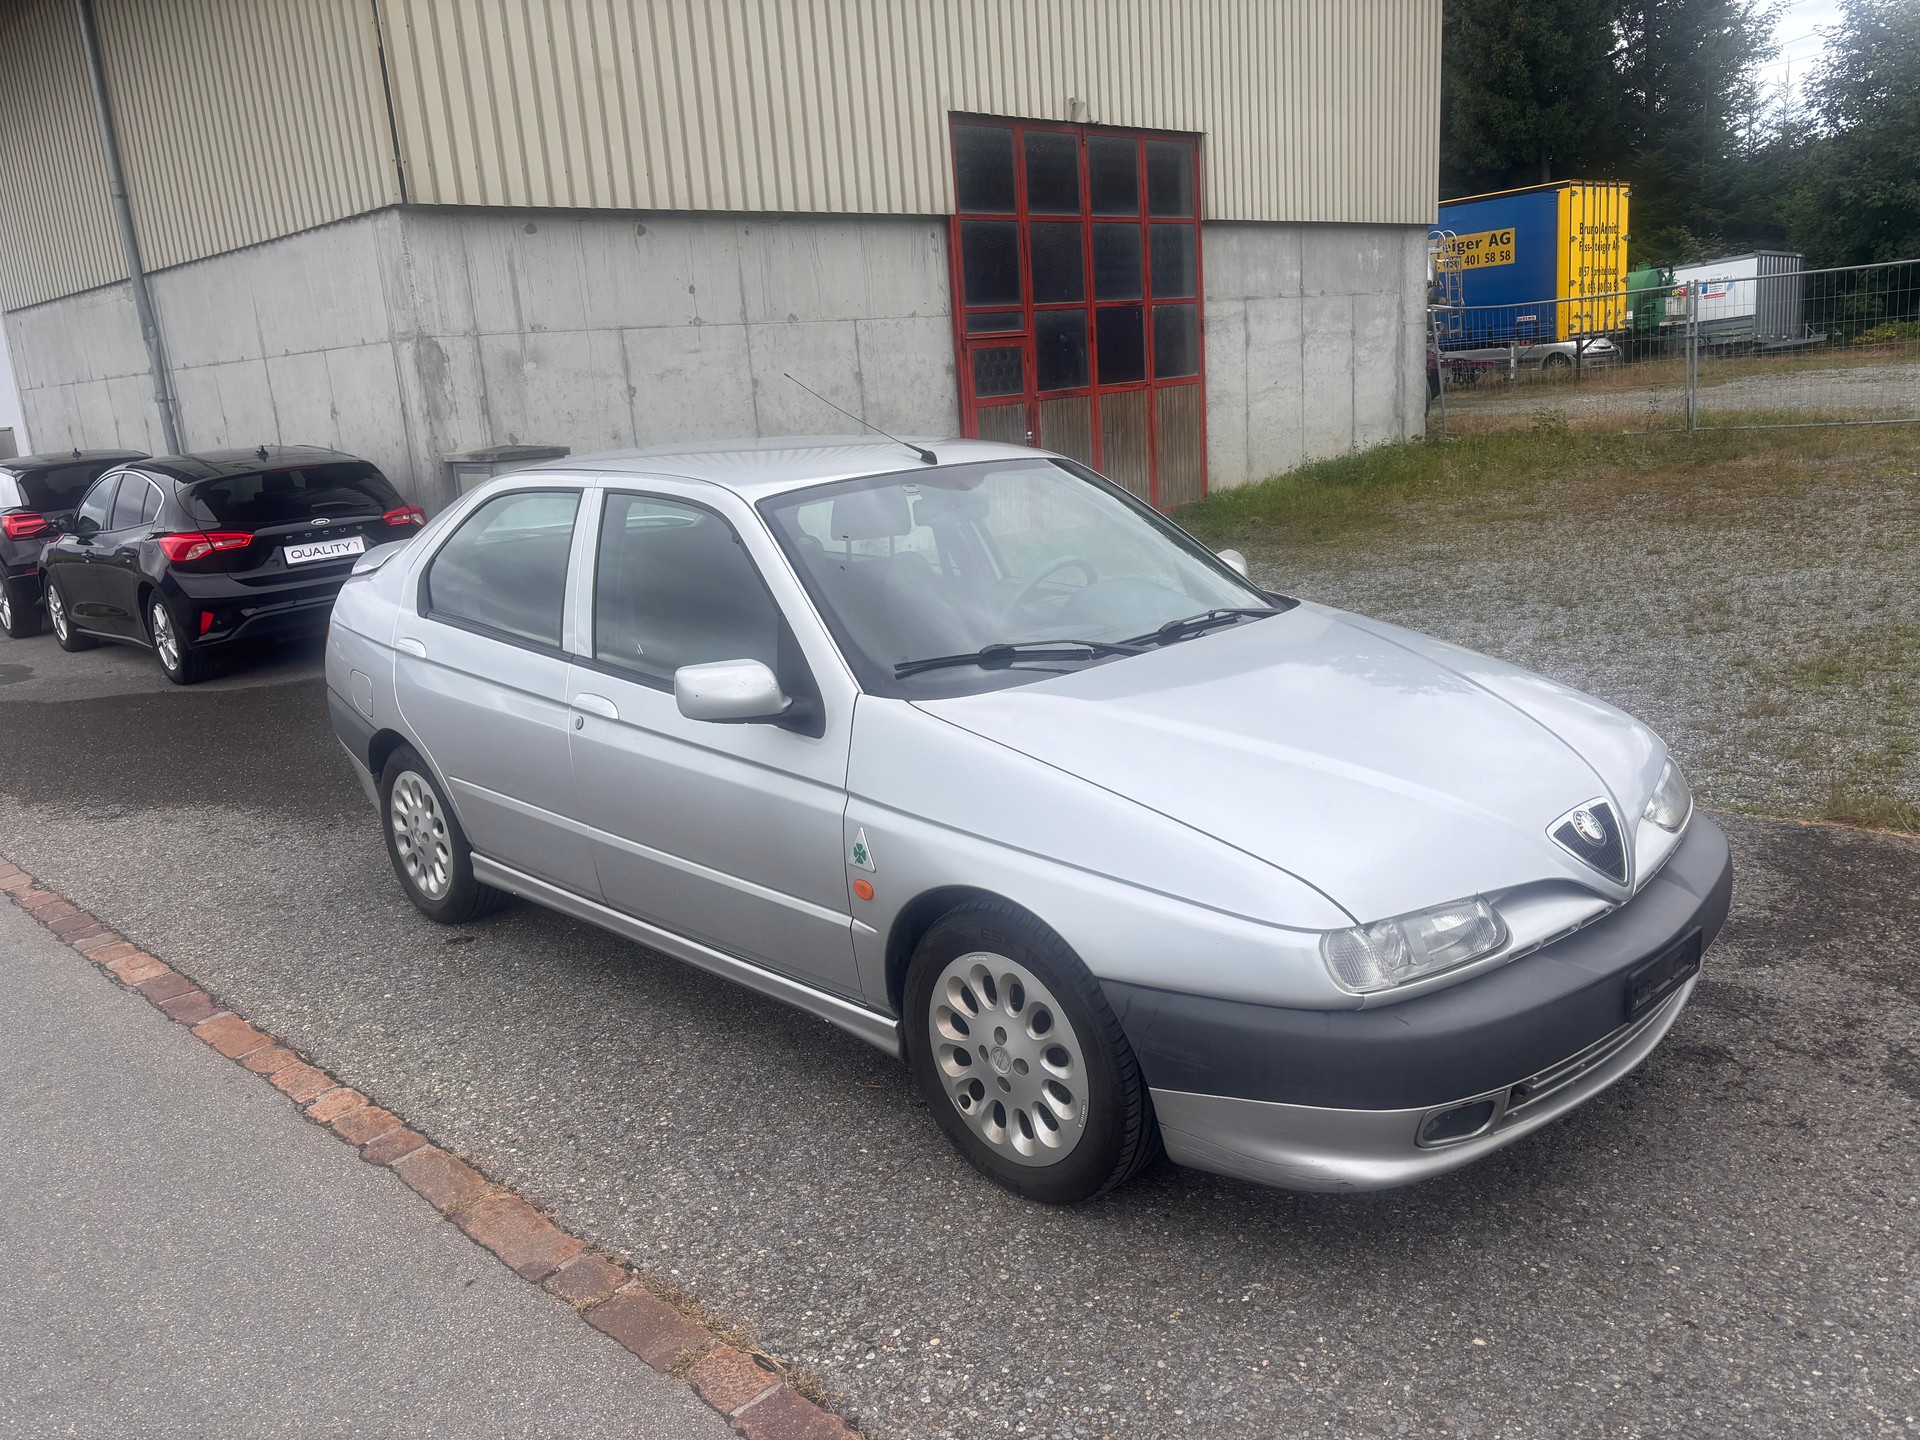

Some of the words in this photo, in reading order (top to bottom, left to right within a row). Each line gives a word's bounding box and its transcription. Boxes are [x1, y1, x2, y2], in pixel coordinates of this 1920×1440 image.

[1489, 232, 1511, 247] AG
[1464, 254, 1480, 266] 401
[1485, 251, 1496, 263] 58
[1500, 250, 1511, 261] 58
[291, 542, 351, 559] QUALITY
